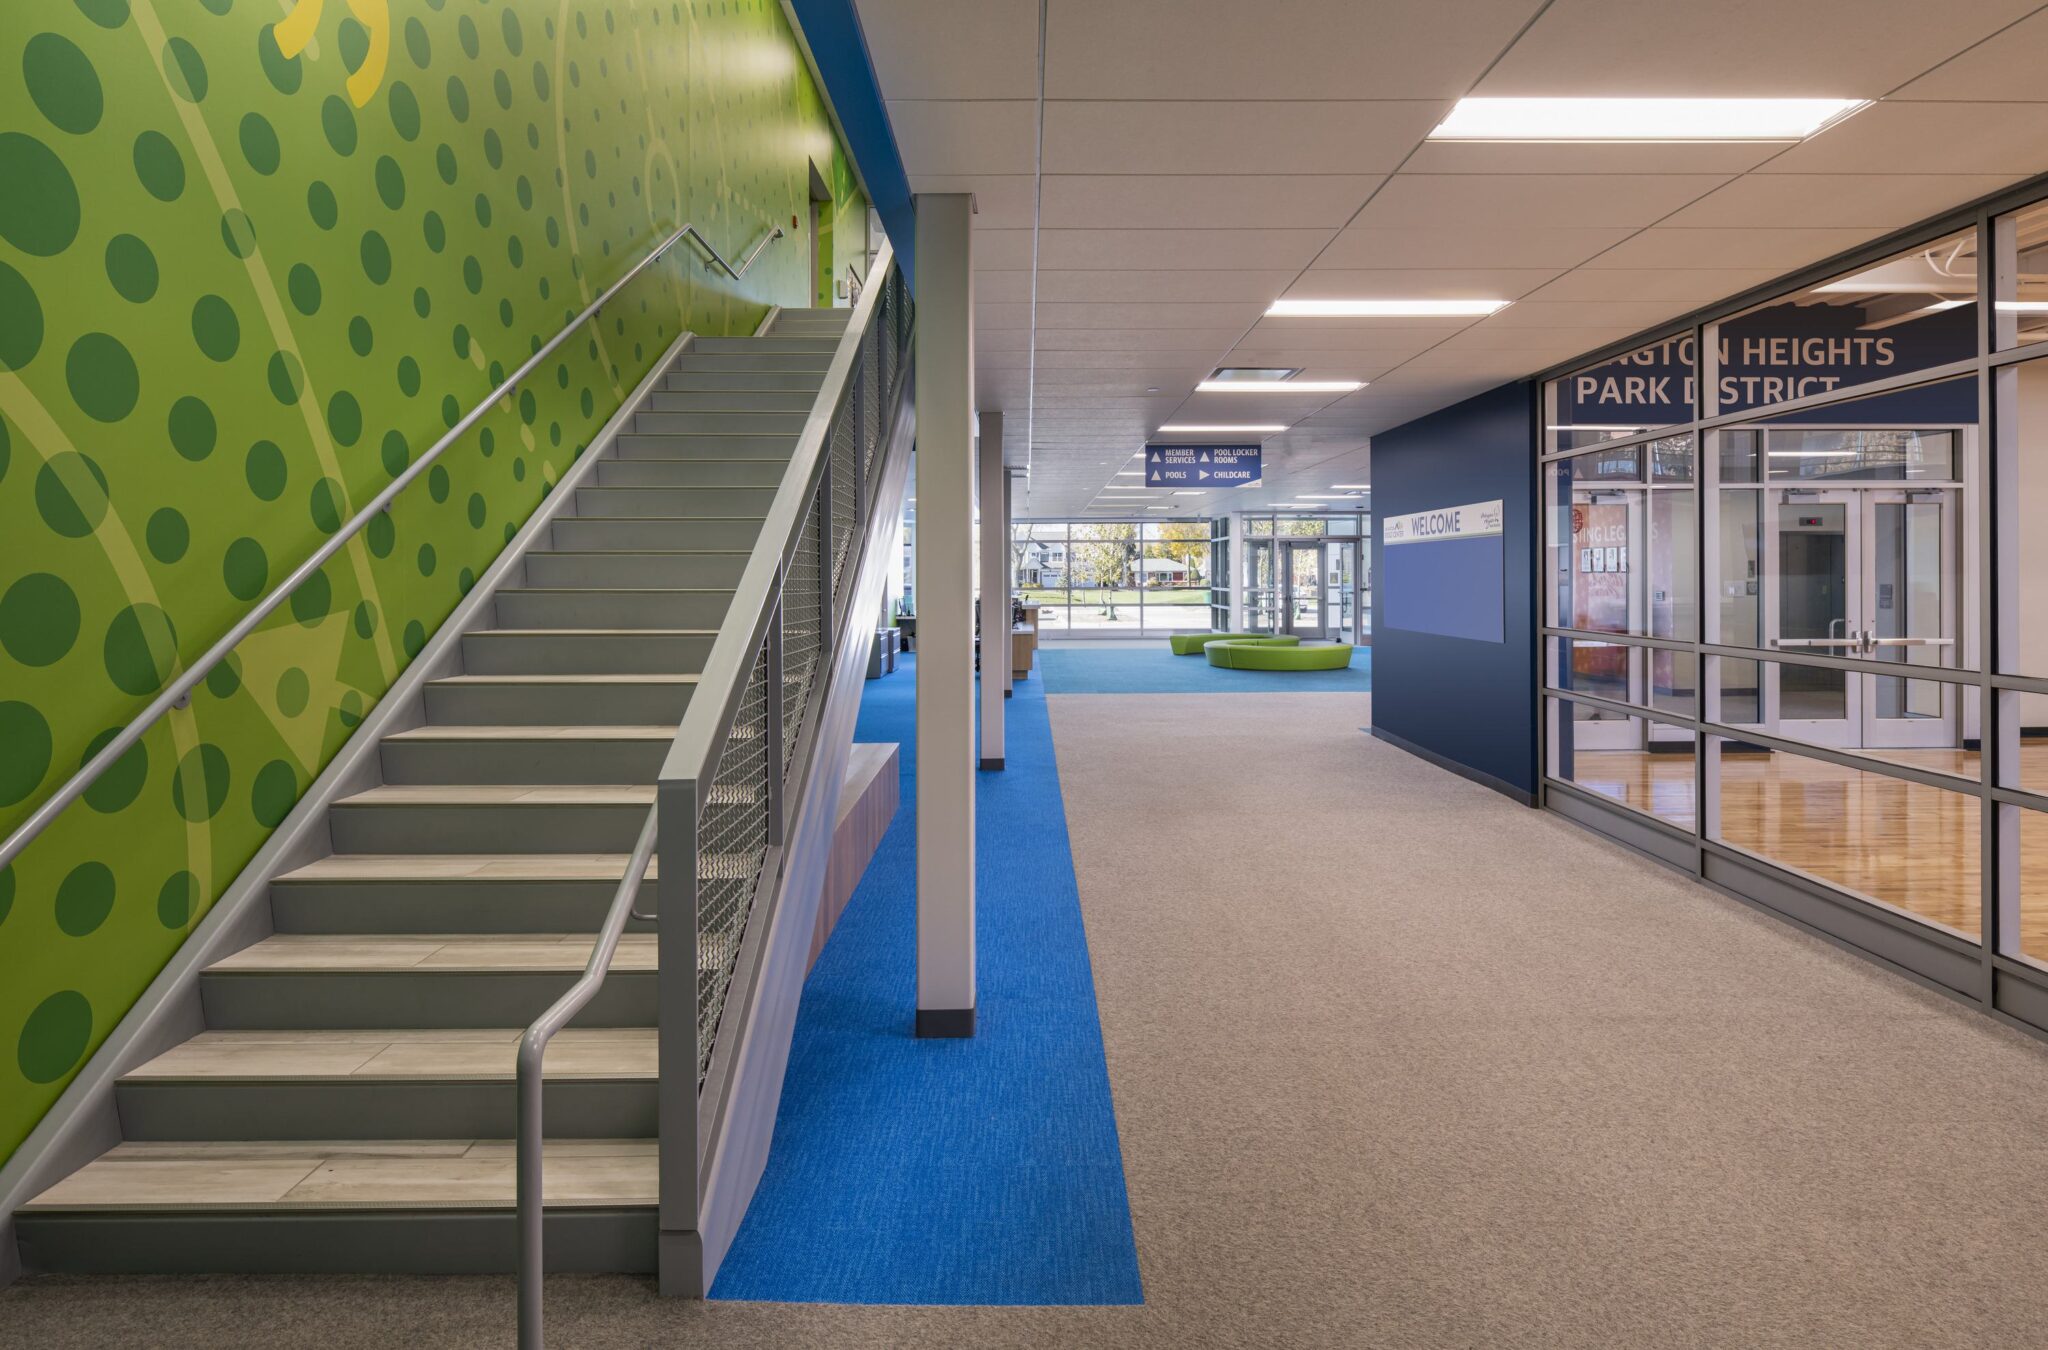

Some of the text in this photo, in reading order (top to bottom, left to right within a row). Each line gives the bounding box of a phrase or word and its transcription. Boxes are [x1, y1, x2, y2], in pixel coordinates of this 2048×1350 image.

[1743, 337, 1895, 366] HEIGHTS
[1577, 377, 1840, 405] PARK DSTRICT
[1411, 511, 1461, 536] WELCOME
[1573, 527, 1602, 544] STING
